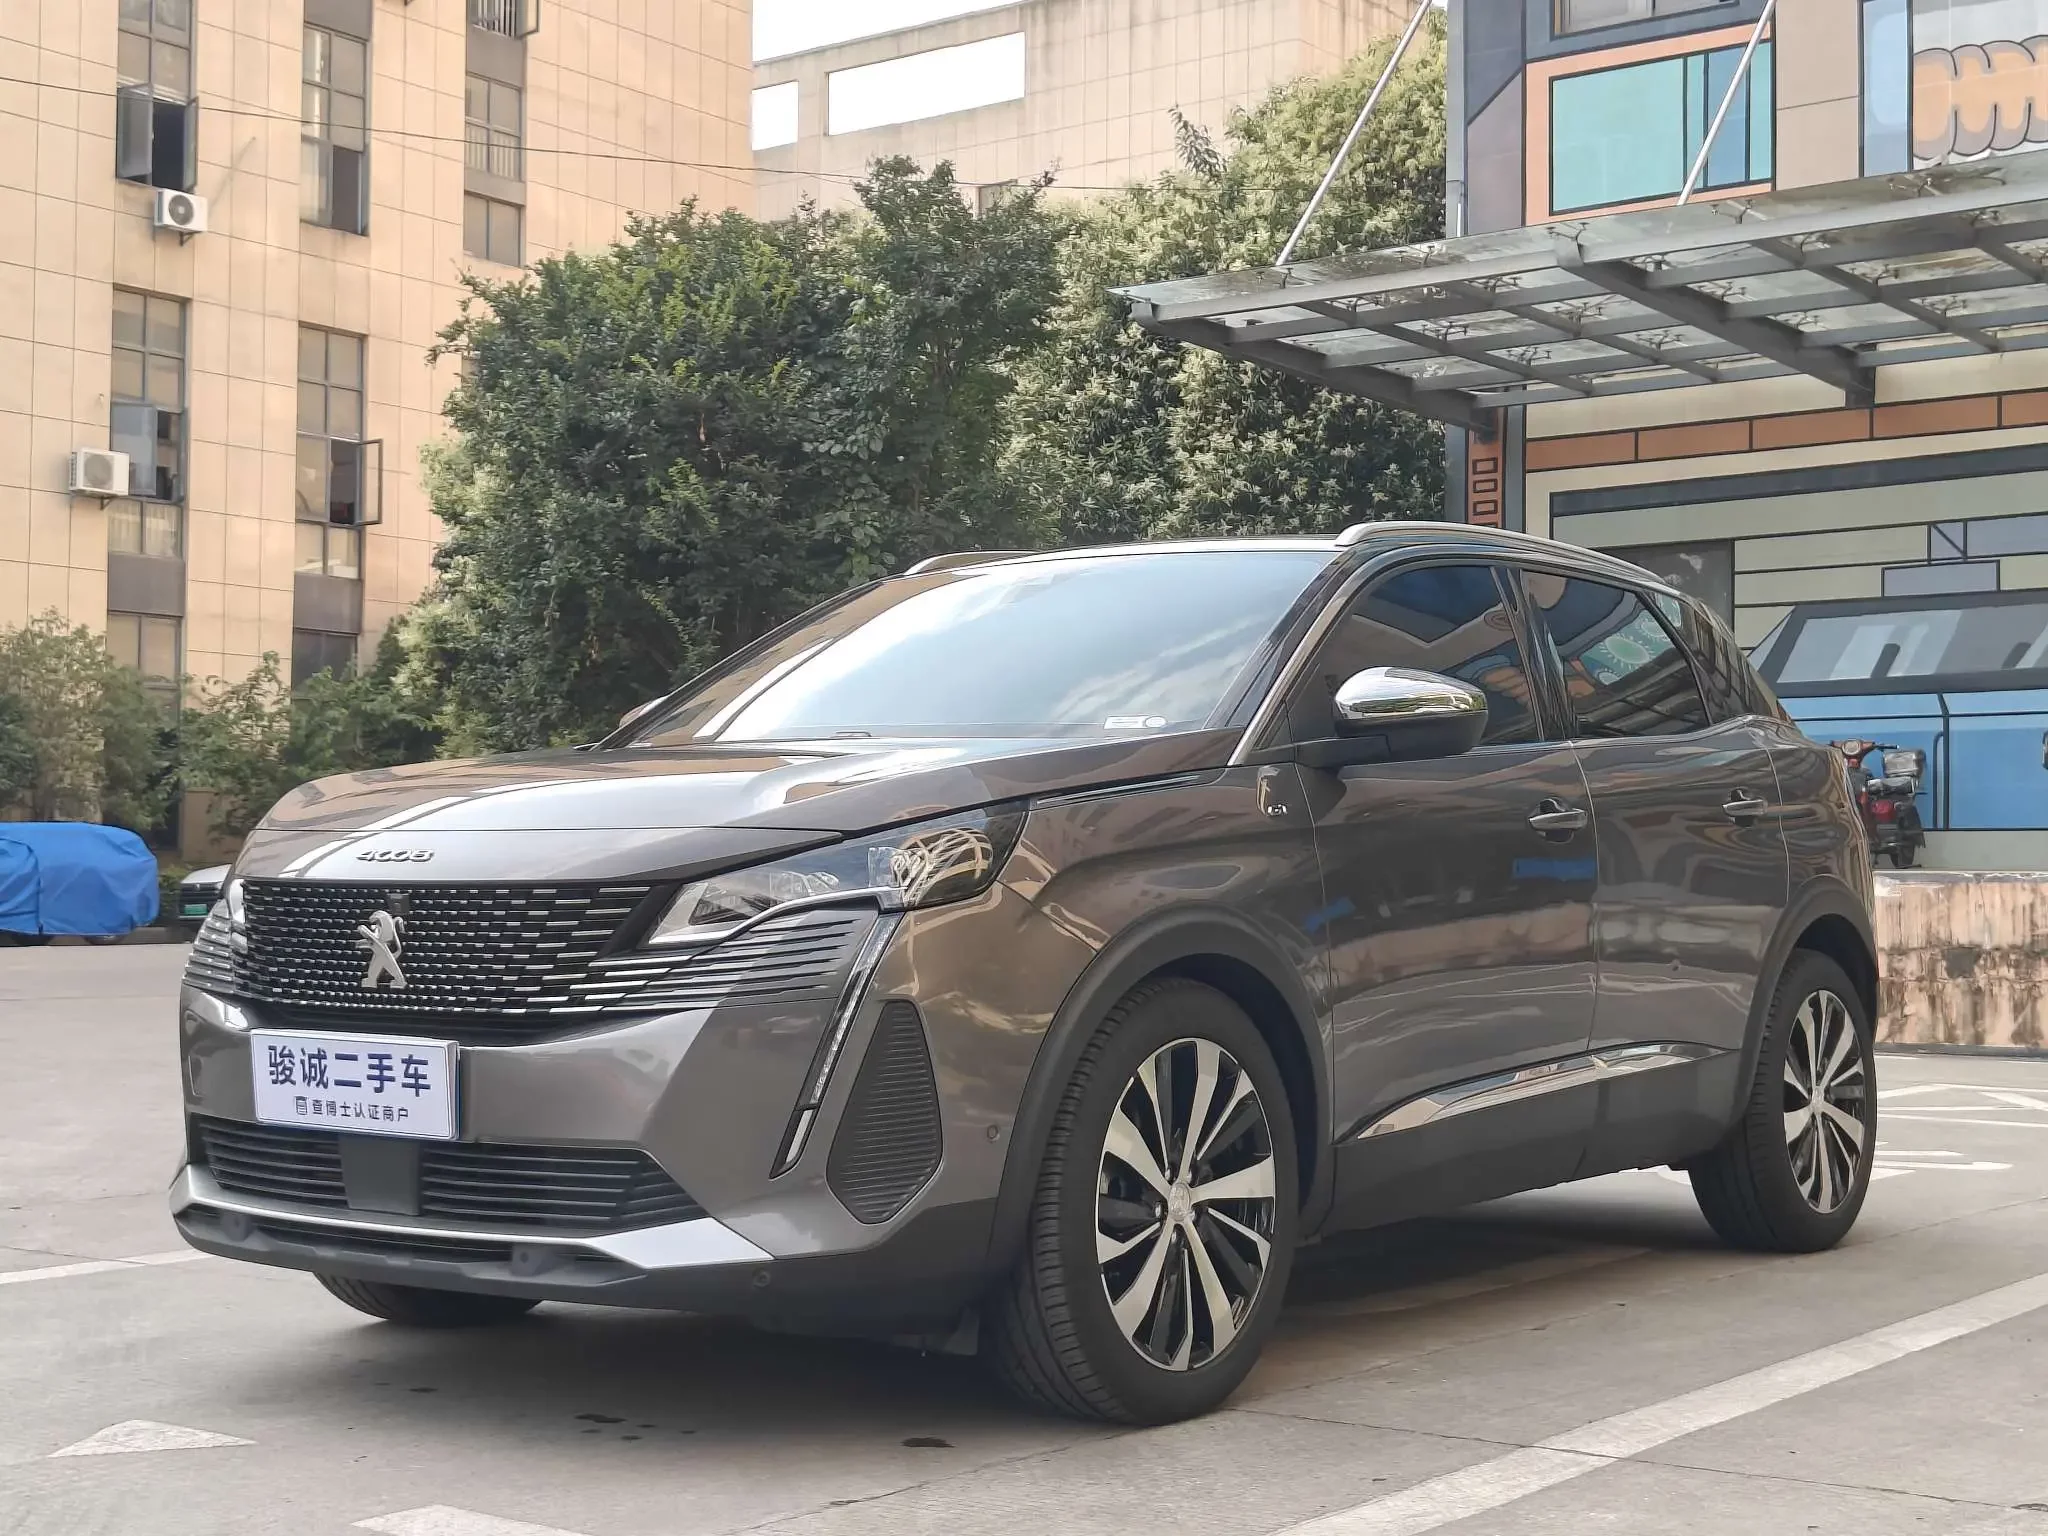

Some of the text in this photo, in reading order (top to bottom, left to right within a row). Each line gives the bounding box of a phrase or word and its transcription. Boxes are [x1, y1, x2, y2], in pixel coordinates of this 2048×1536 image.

[356, 850, 434, 863] 4008
[268, 1045, 431, 1097] 骏诚二手车
[312, 1099, 409, 1122] 查博士认证商户
